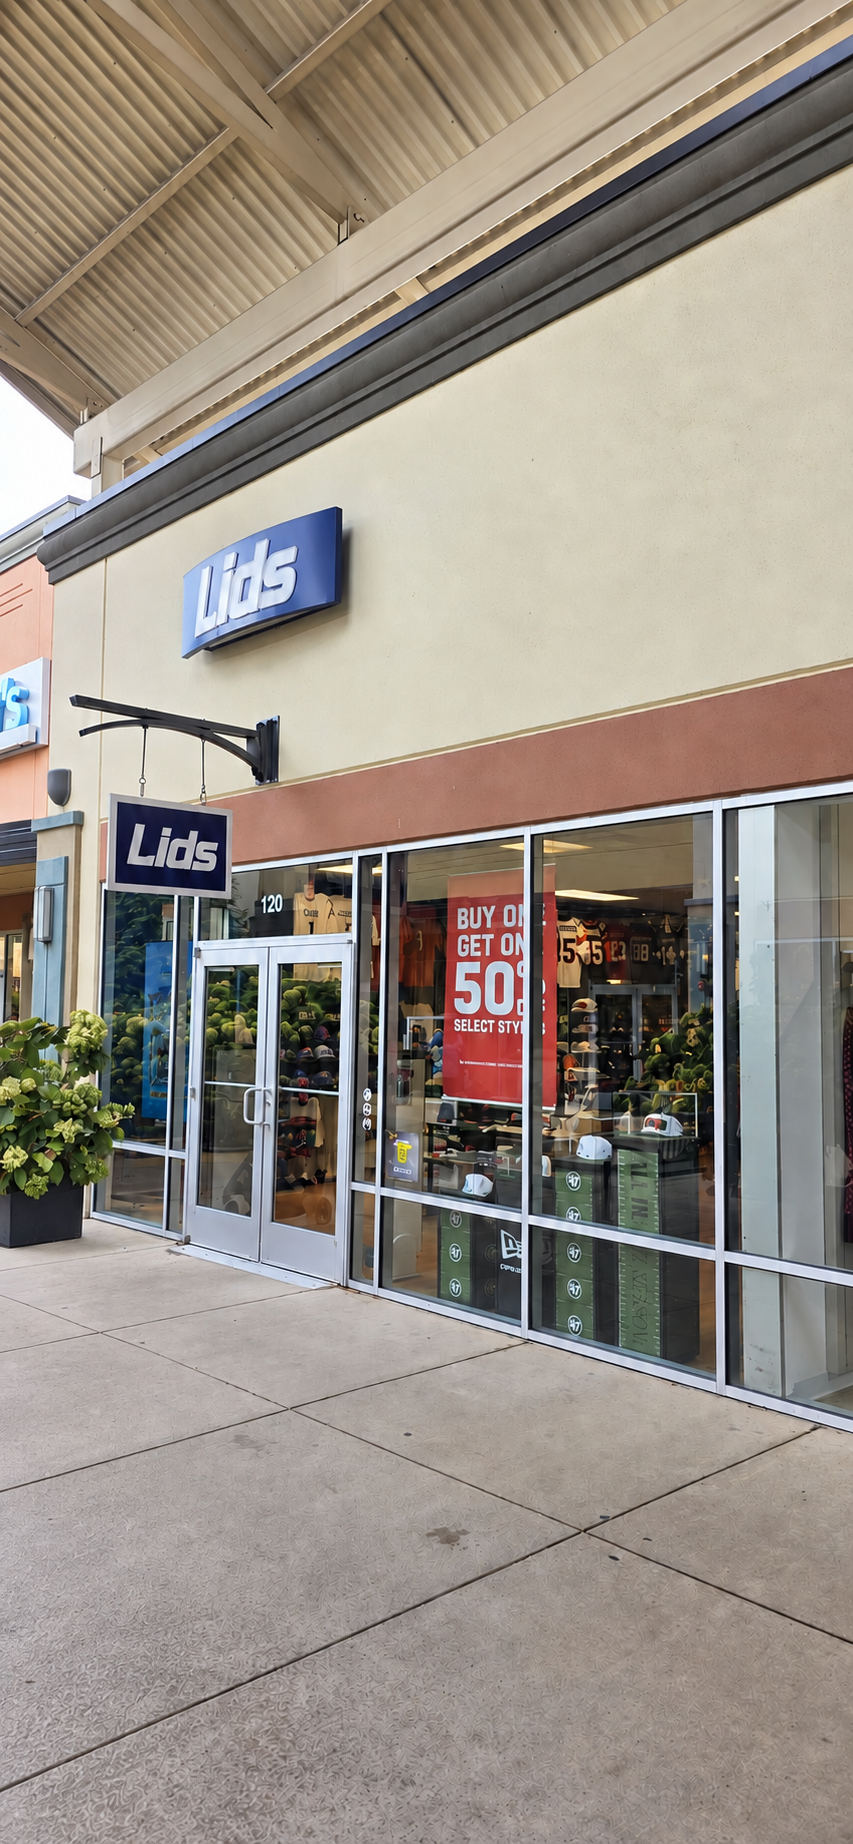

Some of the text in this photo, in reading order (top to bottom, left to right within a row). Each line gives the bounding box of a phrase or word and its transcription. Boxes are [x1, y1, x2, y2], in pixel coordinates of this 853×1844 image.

[195, 538, 299, 638] Lids
[127, 823, 219, 872] Lids
[261, 894, 283, 913] 120
[457, 905, 496, 930] BUY
[457, 933, 495, 957] GET
[454, 1018, 546, 1035] SELECT STY
